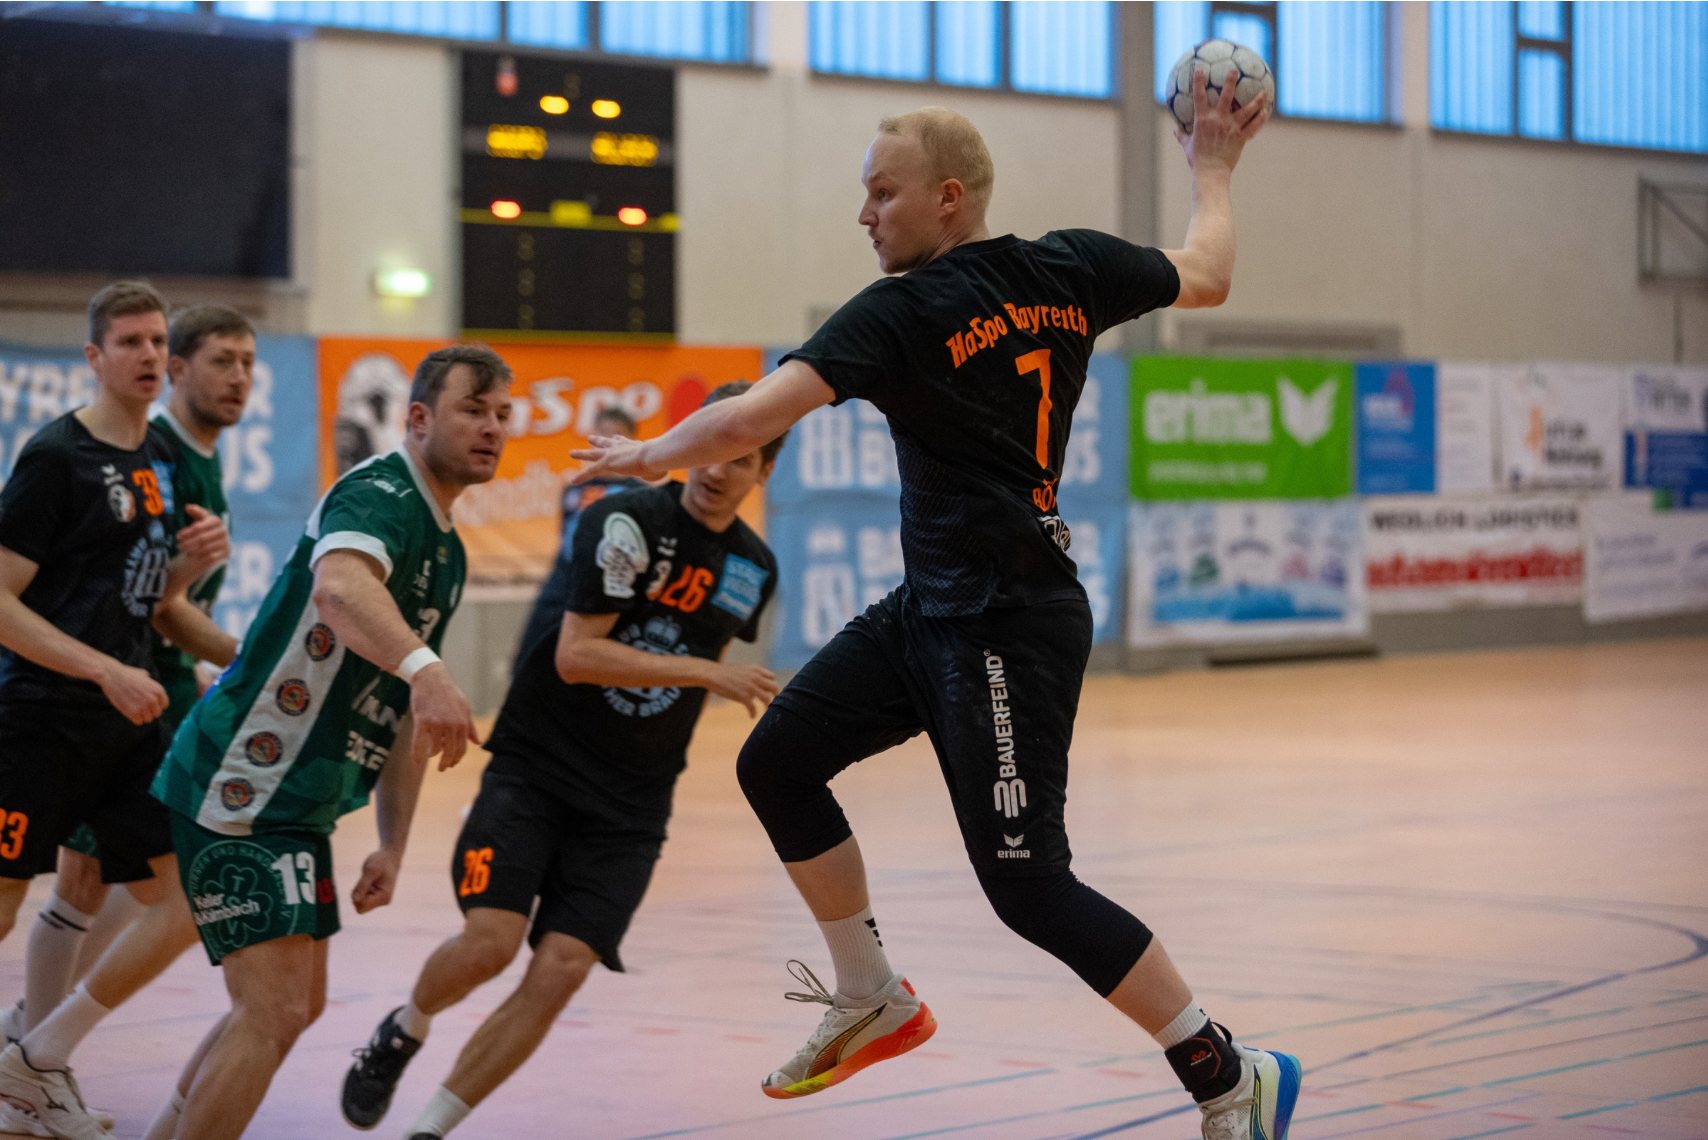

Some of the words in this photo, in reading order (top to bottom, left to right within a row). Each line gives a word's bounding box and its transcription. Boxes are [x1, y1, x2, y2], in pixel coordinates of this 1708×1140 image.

[945, 315, 1008, 369] HaSpo
[1015, 348, 1051, 470] 7
[659, 564, 714, 612] 26
[985, 655, 1017, 778] BAUERFEIND
[271, 851, 316, 905] 13
[459, 846, 494, 897] 26
[997, 848, 1031, 859] erima
